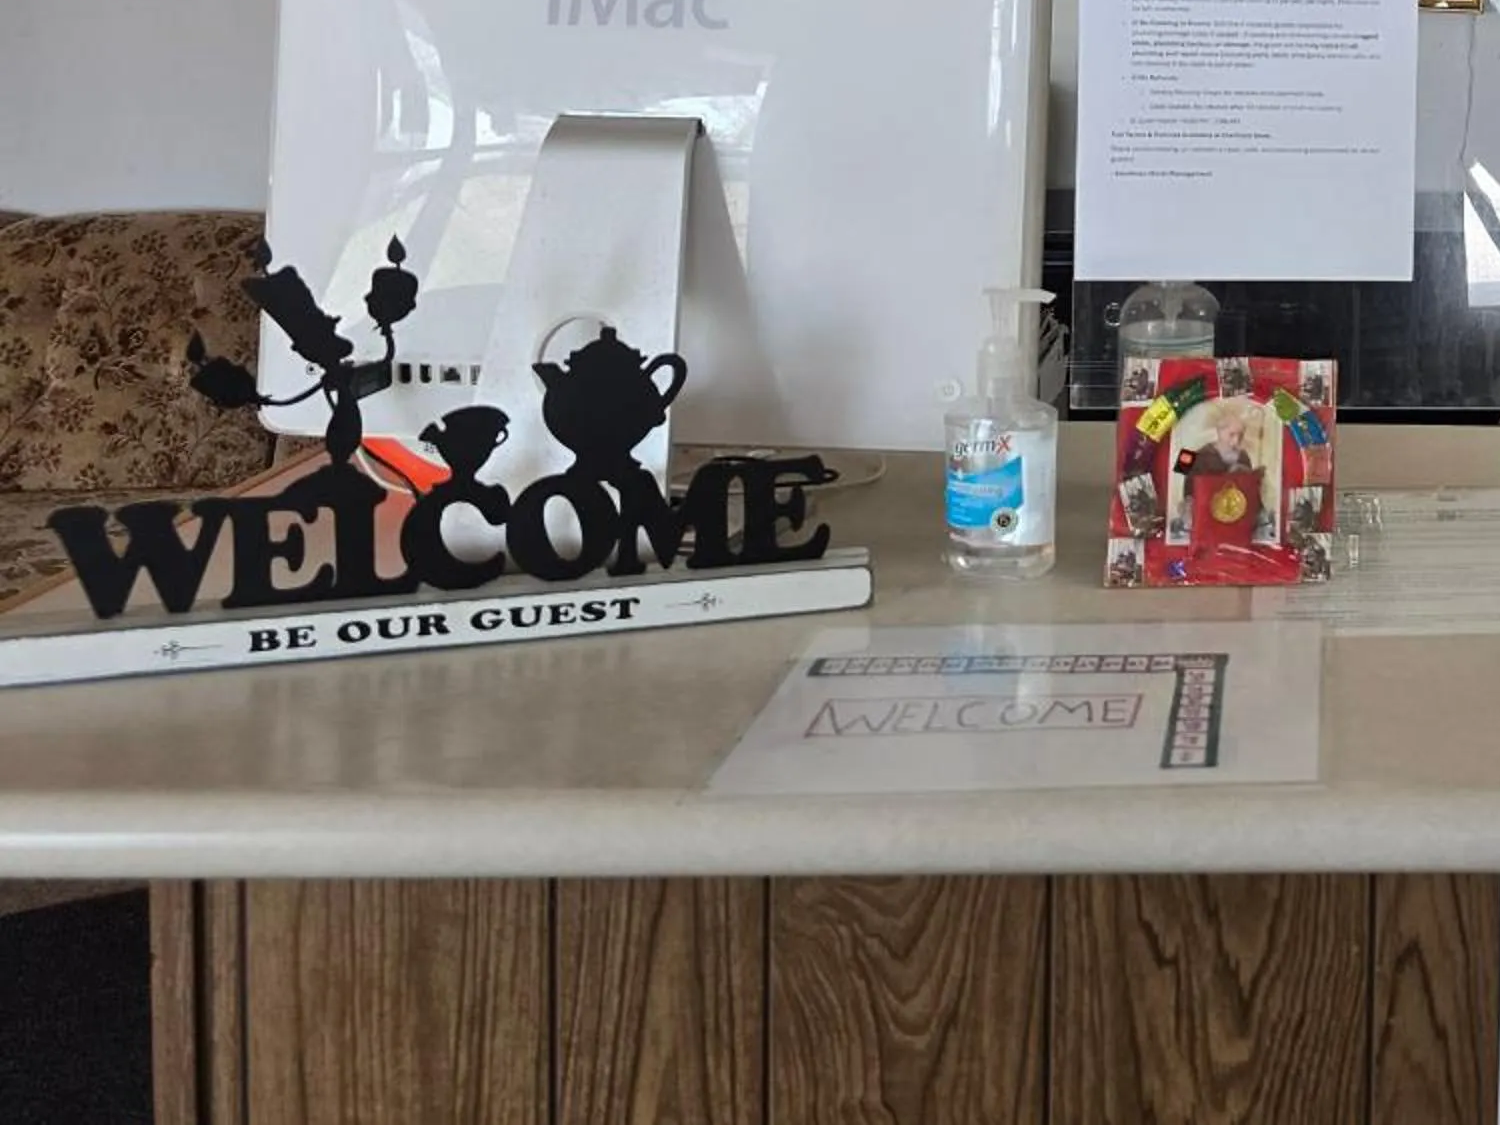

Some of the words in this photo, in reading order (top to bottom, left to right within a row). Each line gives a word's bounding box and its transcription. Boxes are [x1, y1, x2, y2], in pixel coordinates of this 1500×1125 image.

[46, 455, 831, 620] WELCOME
[249, 622, 317, 655] BE
[337, 613, 448, 644] OUR
[470, 596, 642, 631] GUEST
[828, 697, 1130, 742] WELCOME
